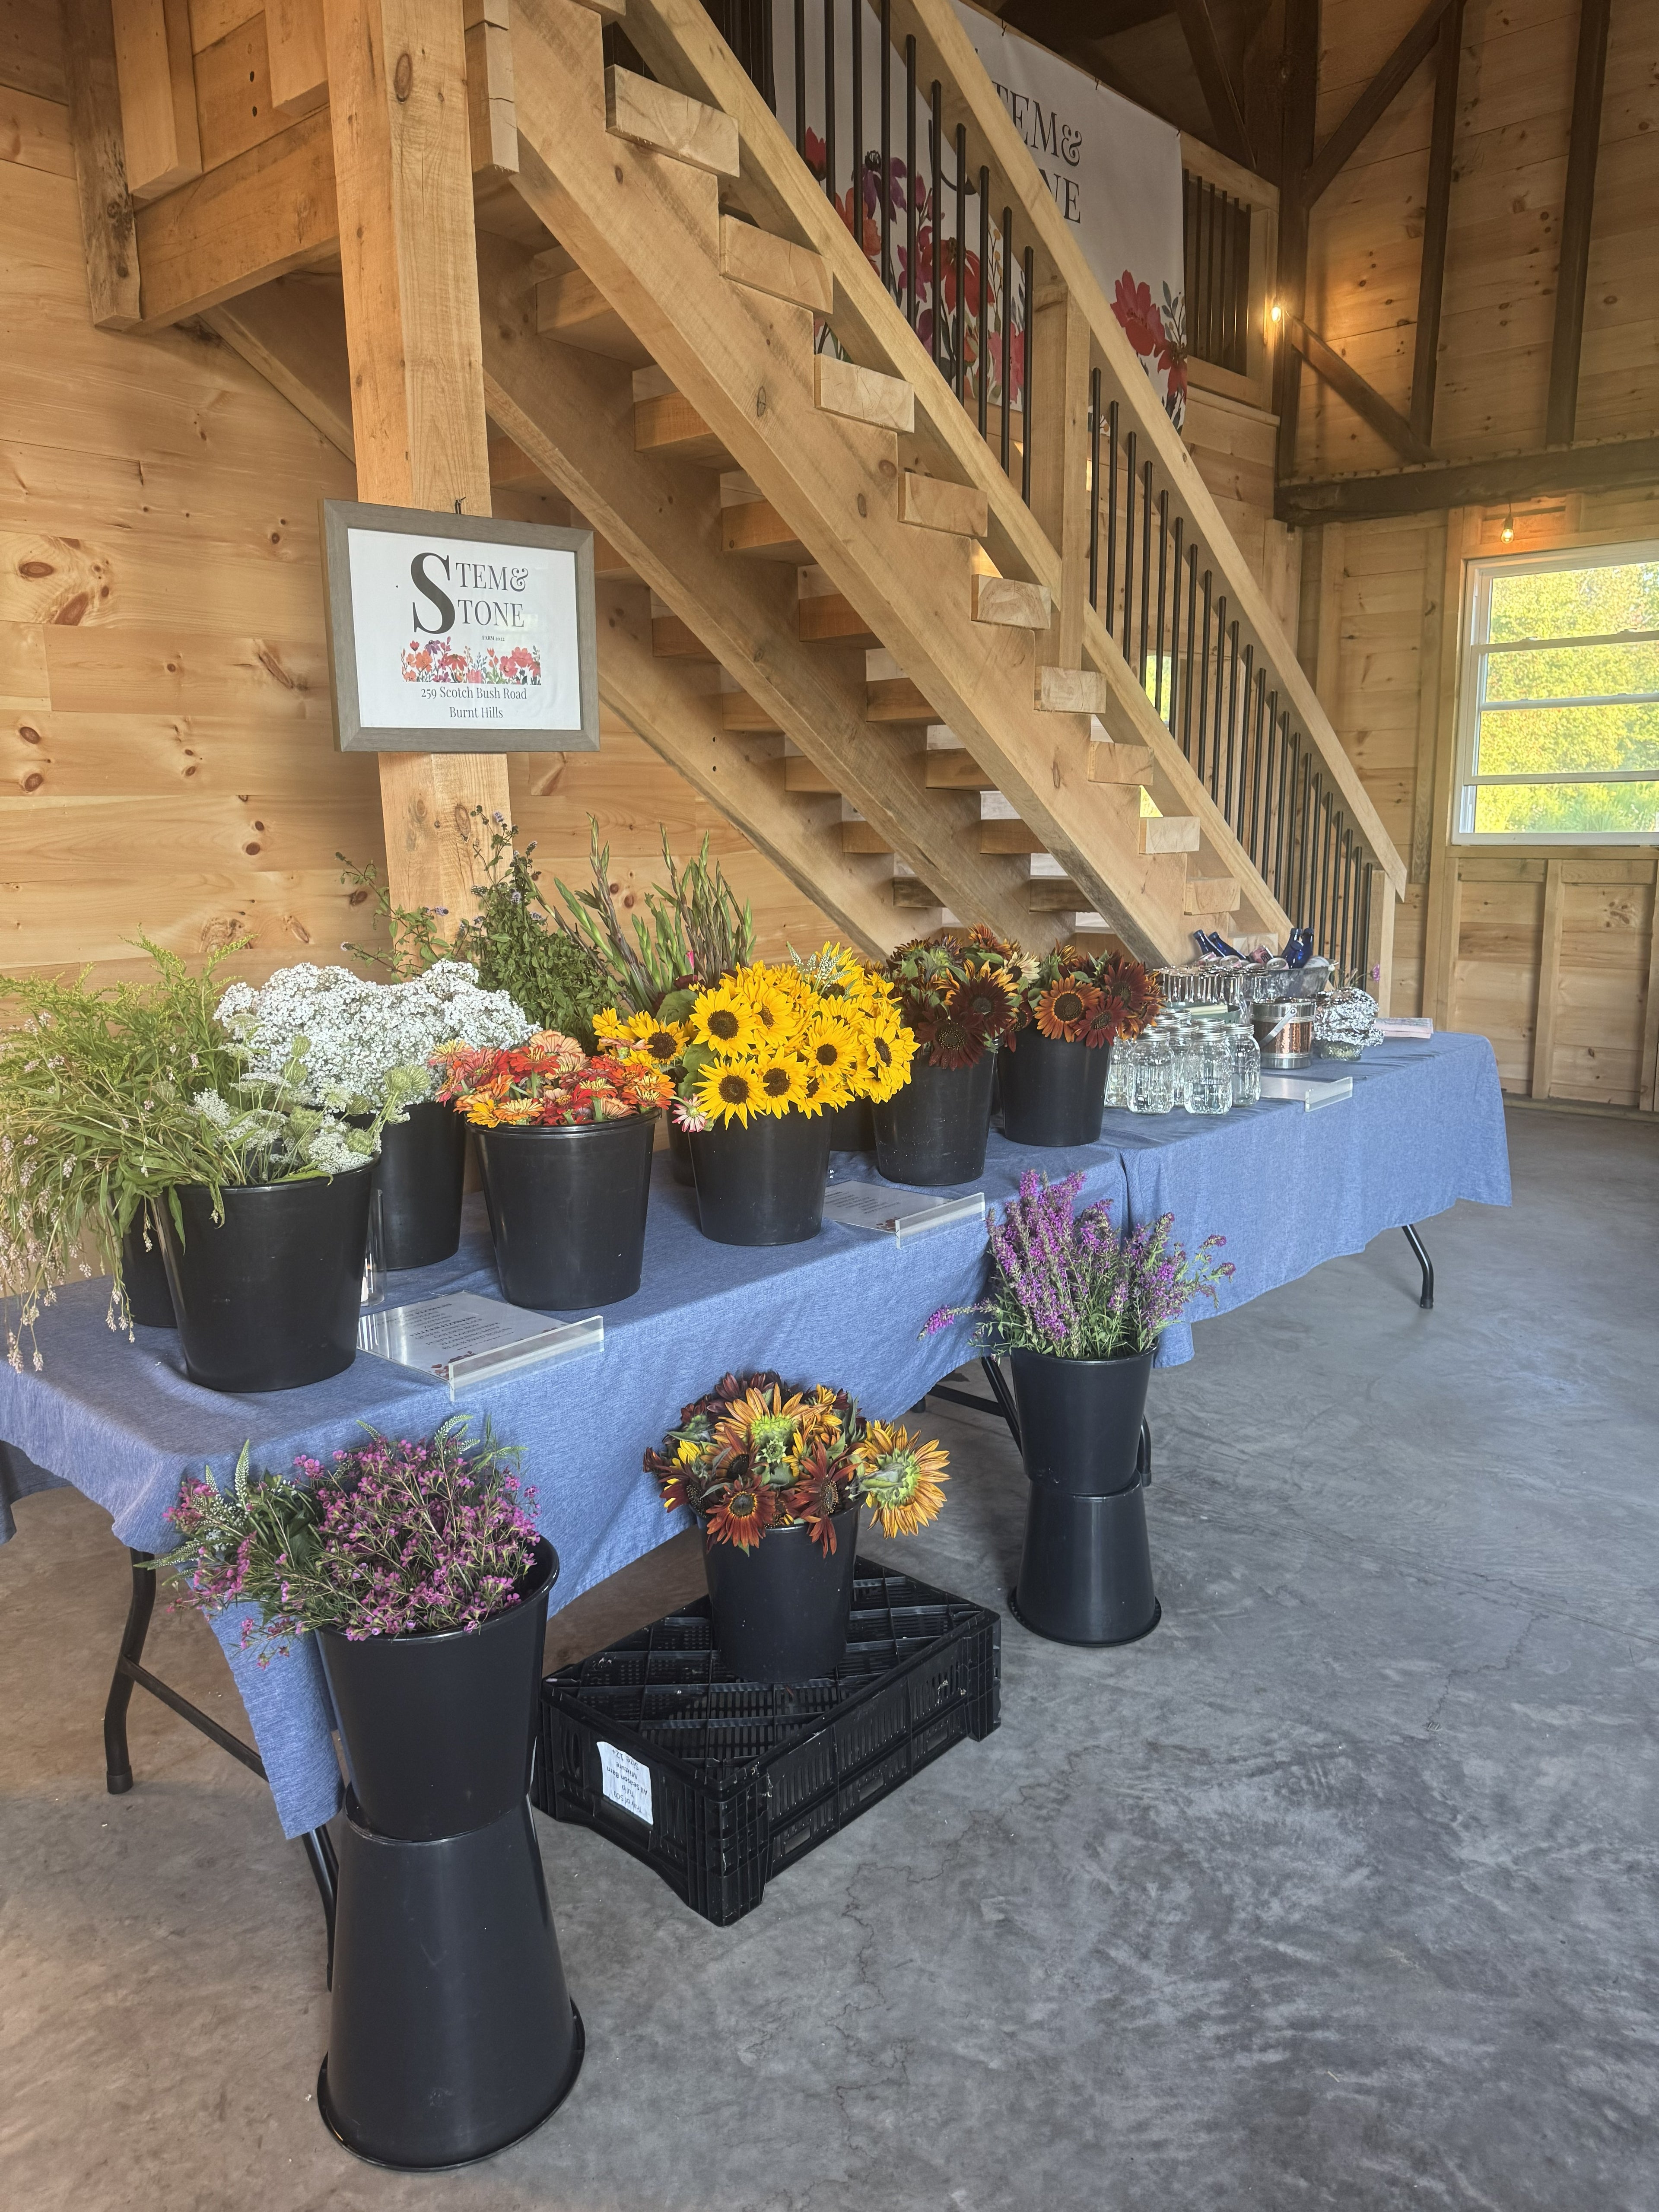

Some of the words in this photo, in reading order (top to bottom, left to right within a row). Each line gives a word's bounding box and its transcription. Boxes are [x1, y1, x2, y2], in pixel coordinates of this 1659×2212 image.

[421, 688, 437, 699] 259
[440, 686, 474, 699] Scotch
[477, 687, 500, 699] Bush
[503, 687, 527, 699] Road
[449, 706, 478, 718] Burnt
[481, 707, 503, 718] Hills
[612, 1750, 623, 1761] 12+
[626, 1756, 639, 1770] Size
[607, 1766, 619, 1778] Barn
[617, 1762, 637, 1779] Mixture
[621, 1775, 639, 1790] Season
[613, 1791, 624, 1801] 500
[622, 1785, 634, 1797] Tulip
[632, 1802, 642, 1812] Tray
